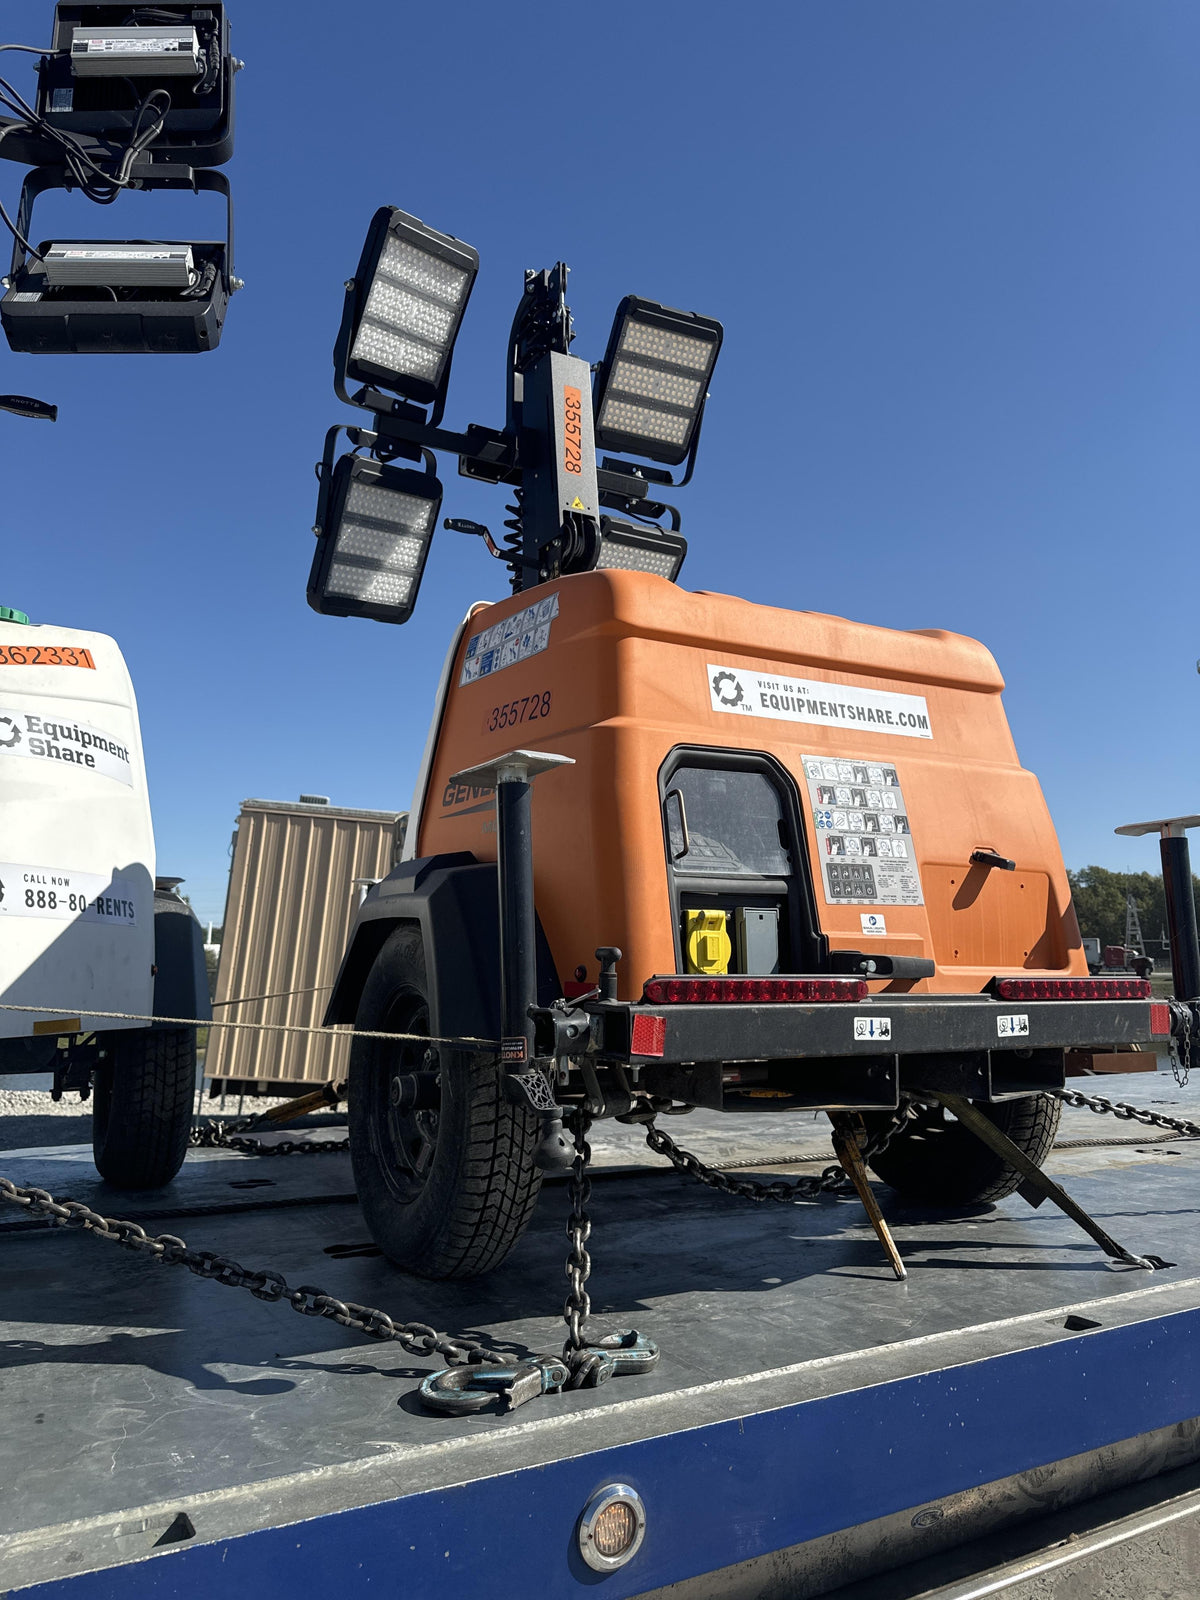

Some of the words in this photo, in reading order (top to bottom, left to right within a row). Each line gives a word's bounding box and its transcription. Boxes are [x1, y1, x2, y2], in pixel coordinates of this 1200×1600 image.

[565, 397, 582, 474] 355728
[757, 680, 780, 691] VISIT
[783, 681, 794, 692] US
[797, 686, 810, 695] AT:
[489, 690, 551, 732] 355728
[759, 692, 929, 730] EQUIPMENTSHARE.COM
[24, 714, 130, 764] Equipment
[28, 737, 96, 768] Share
[23, 874, 47, 885] CALL
[51, 876, 70, 887] NOW
[25, 889, 135, 918] 888-80-RENTS
